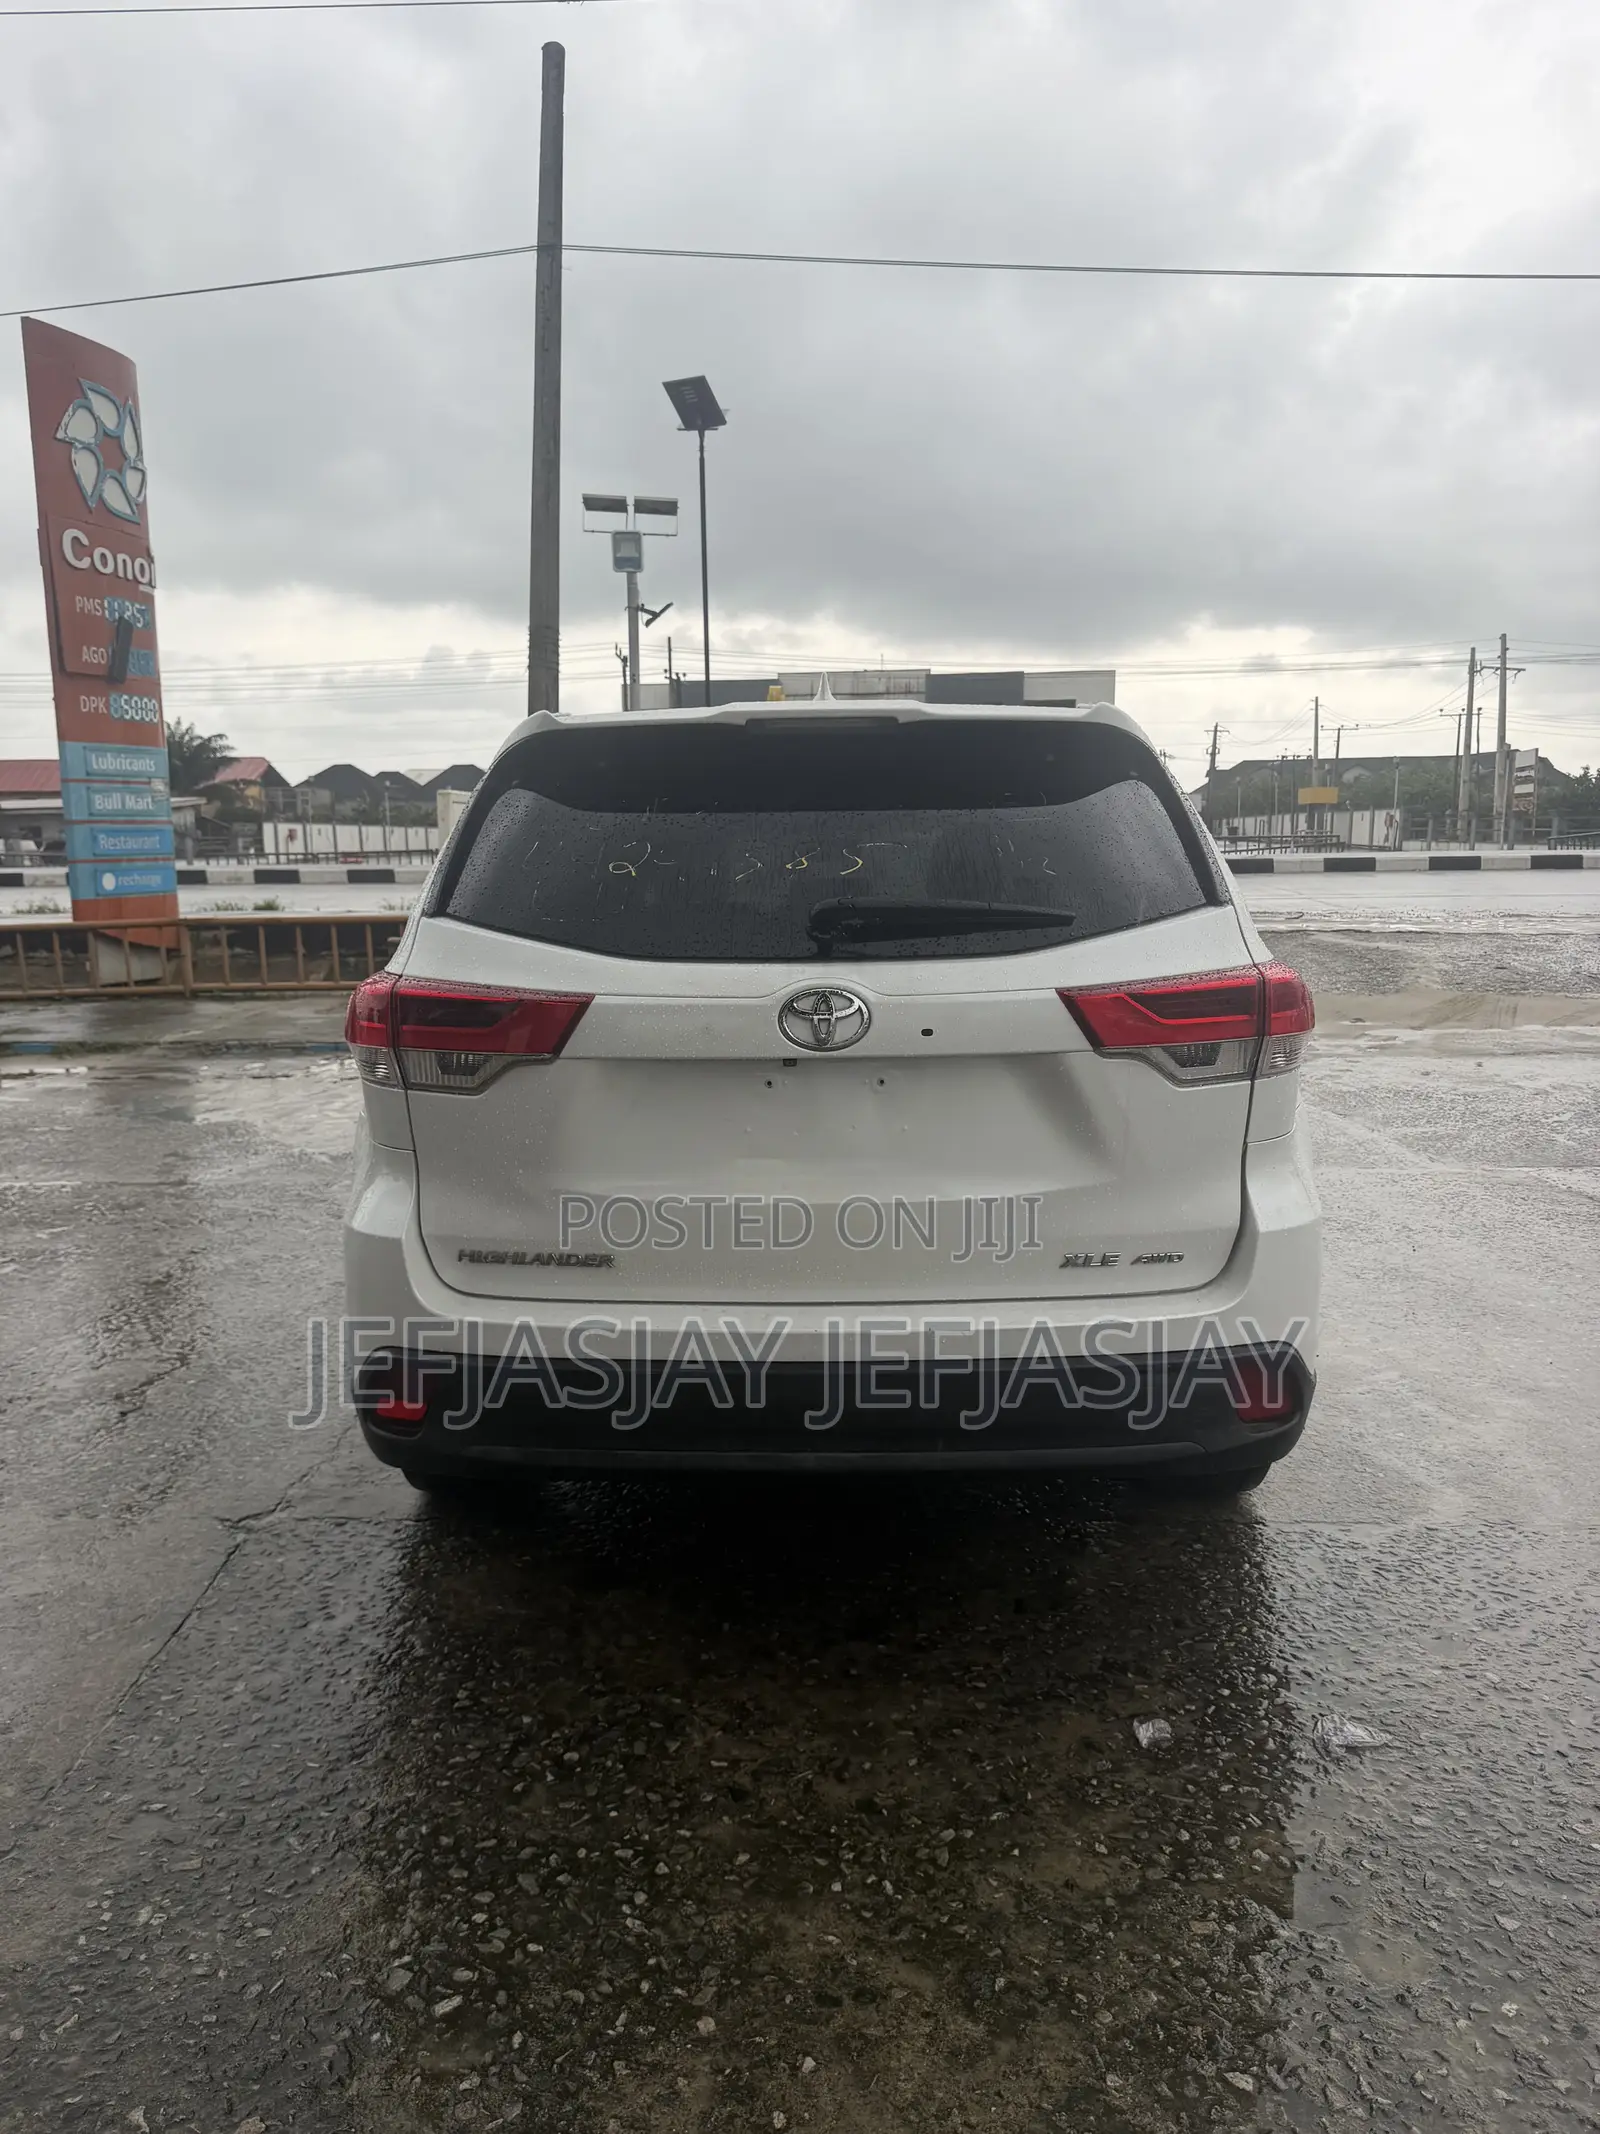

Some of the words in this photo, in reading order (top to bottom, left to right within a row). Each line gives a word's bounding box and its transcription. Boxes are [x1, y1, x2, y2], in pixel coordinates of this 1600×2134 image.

[75, 595, 103, 616] PMS
[82, 645, 108, 665] AGO
[80, 695, 108, 714] DPK
[92, 752, 156, 772] Lubricants
[95, 793, 122, 810] Bull
[125, 794, 153, 810] Mart
[100, 834, 160, 849] Restaurant
[457, 1249, 617, 1269] HIGHLANDER
[1058, 1251, 1122, 1270] XLE
[1129, 1251, 1185, 1267] AWD
